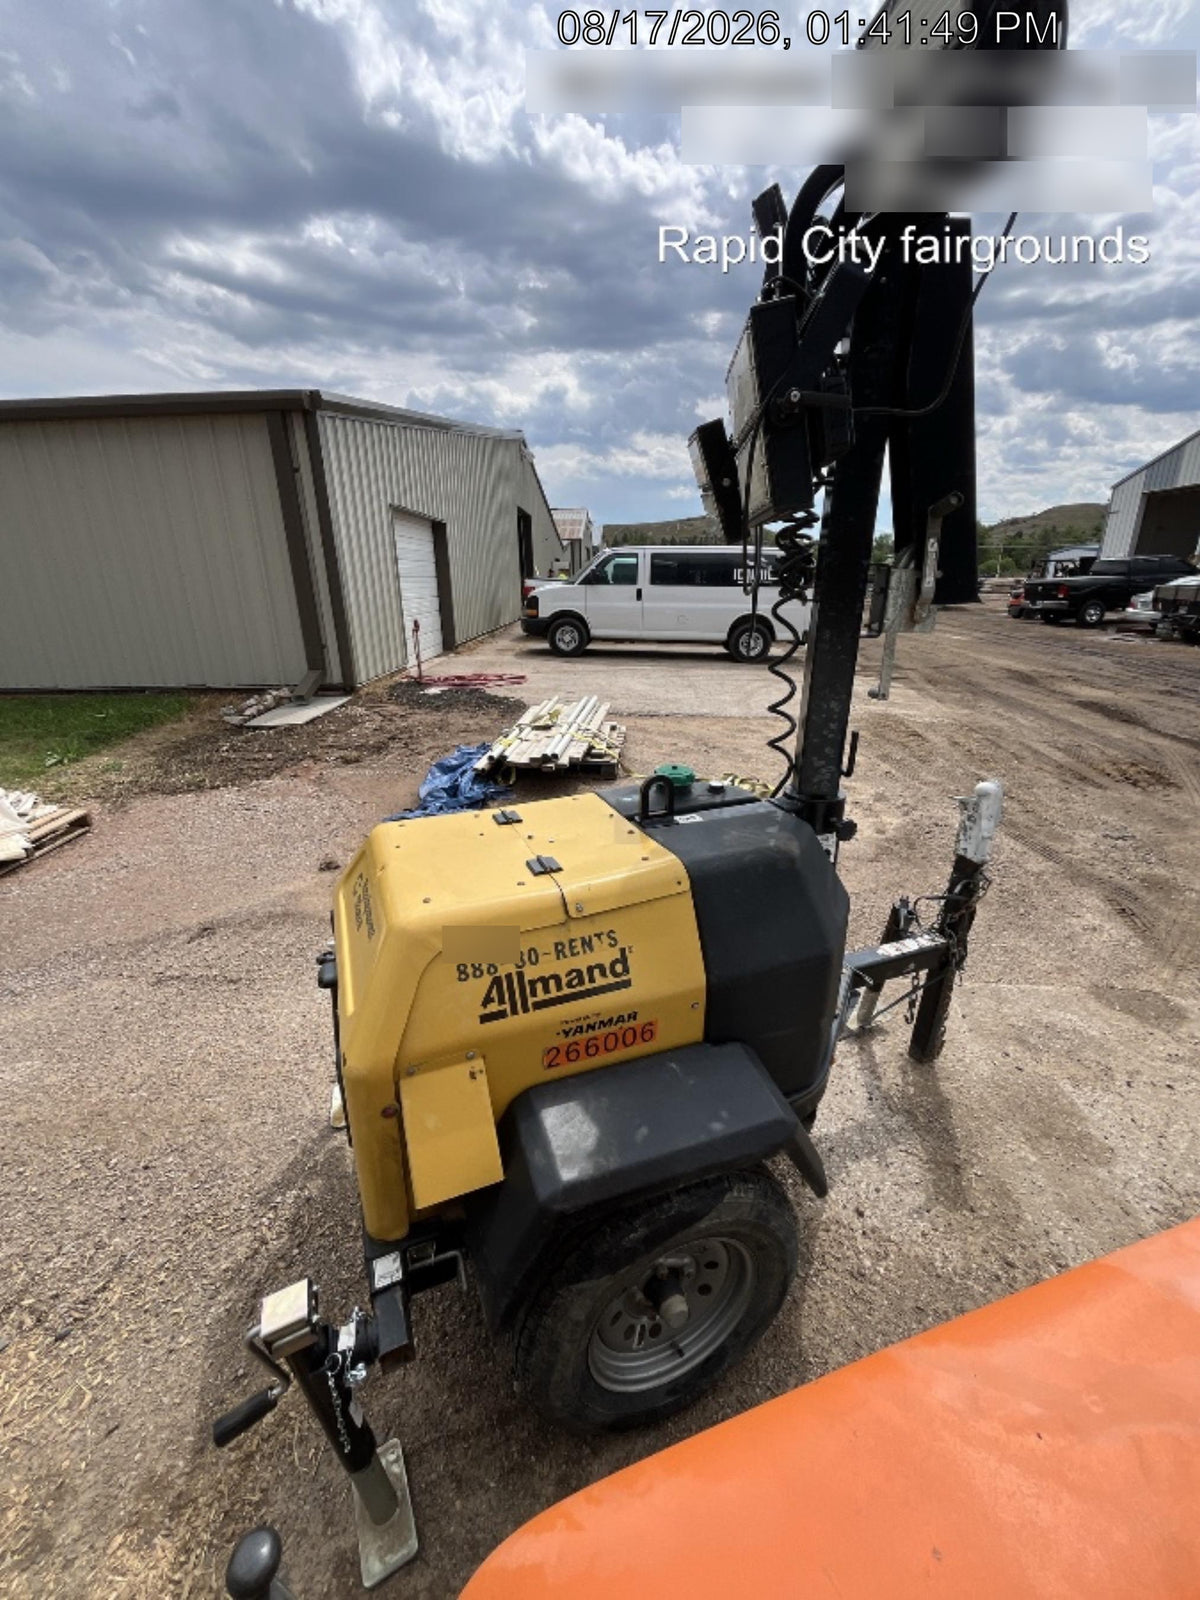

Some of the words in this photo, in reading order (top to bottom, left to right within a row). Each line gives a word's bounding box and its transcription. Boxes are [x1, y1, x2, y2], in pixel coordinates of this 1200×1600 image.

[480, 947, 630, 1016] Allmand
[546, 1021, 655, 1068] 266006
[561, 1011, 638, 1038] YANMAR
